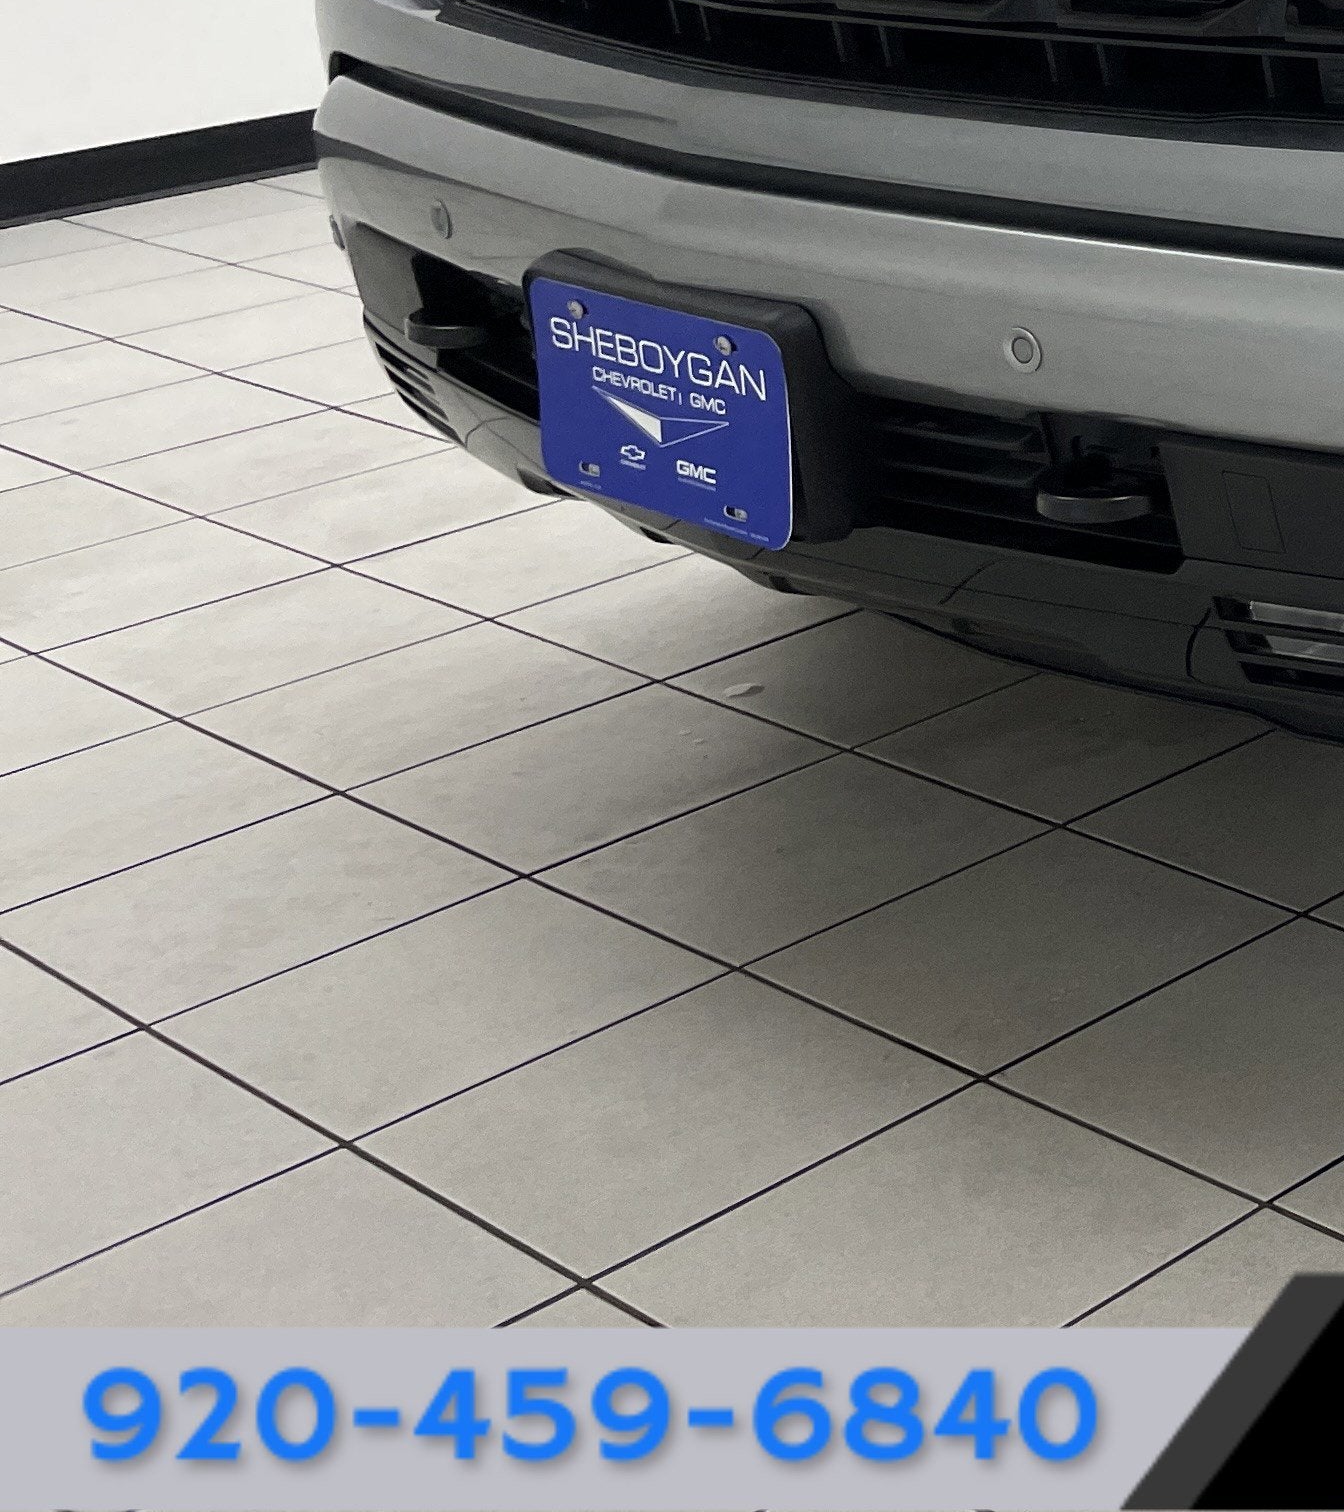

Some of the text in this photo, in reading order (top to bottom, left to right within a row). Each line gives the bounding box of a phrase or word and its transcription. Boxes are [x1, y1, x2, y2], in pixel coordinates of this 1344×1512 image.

[549, 316, 767, 402] SHEBOYGAN
[592, 366, 726, 415] CHEVROLET GMC
[676, 459, 717, 485] GMC
